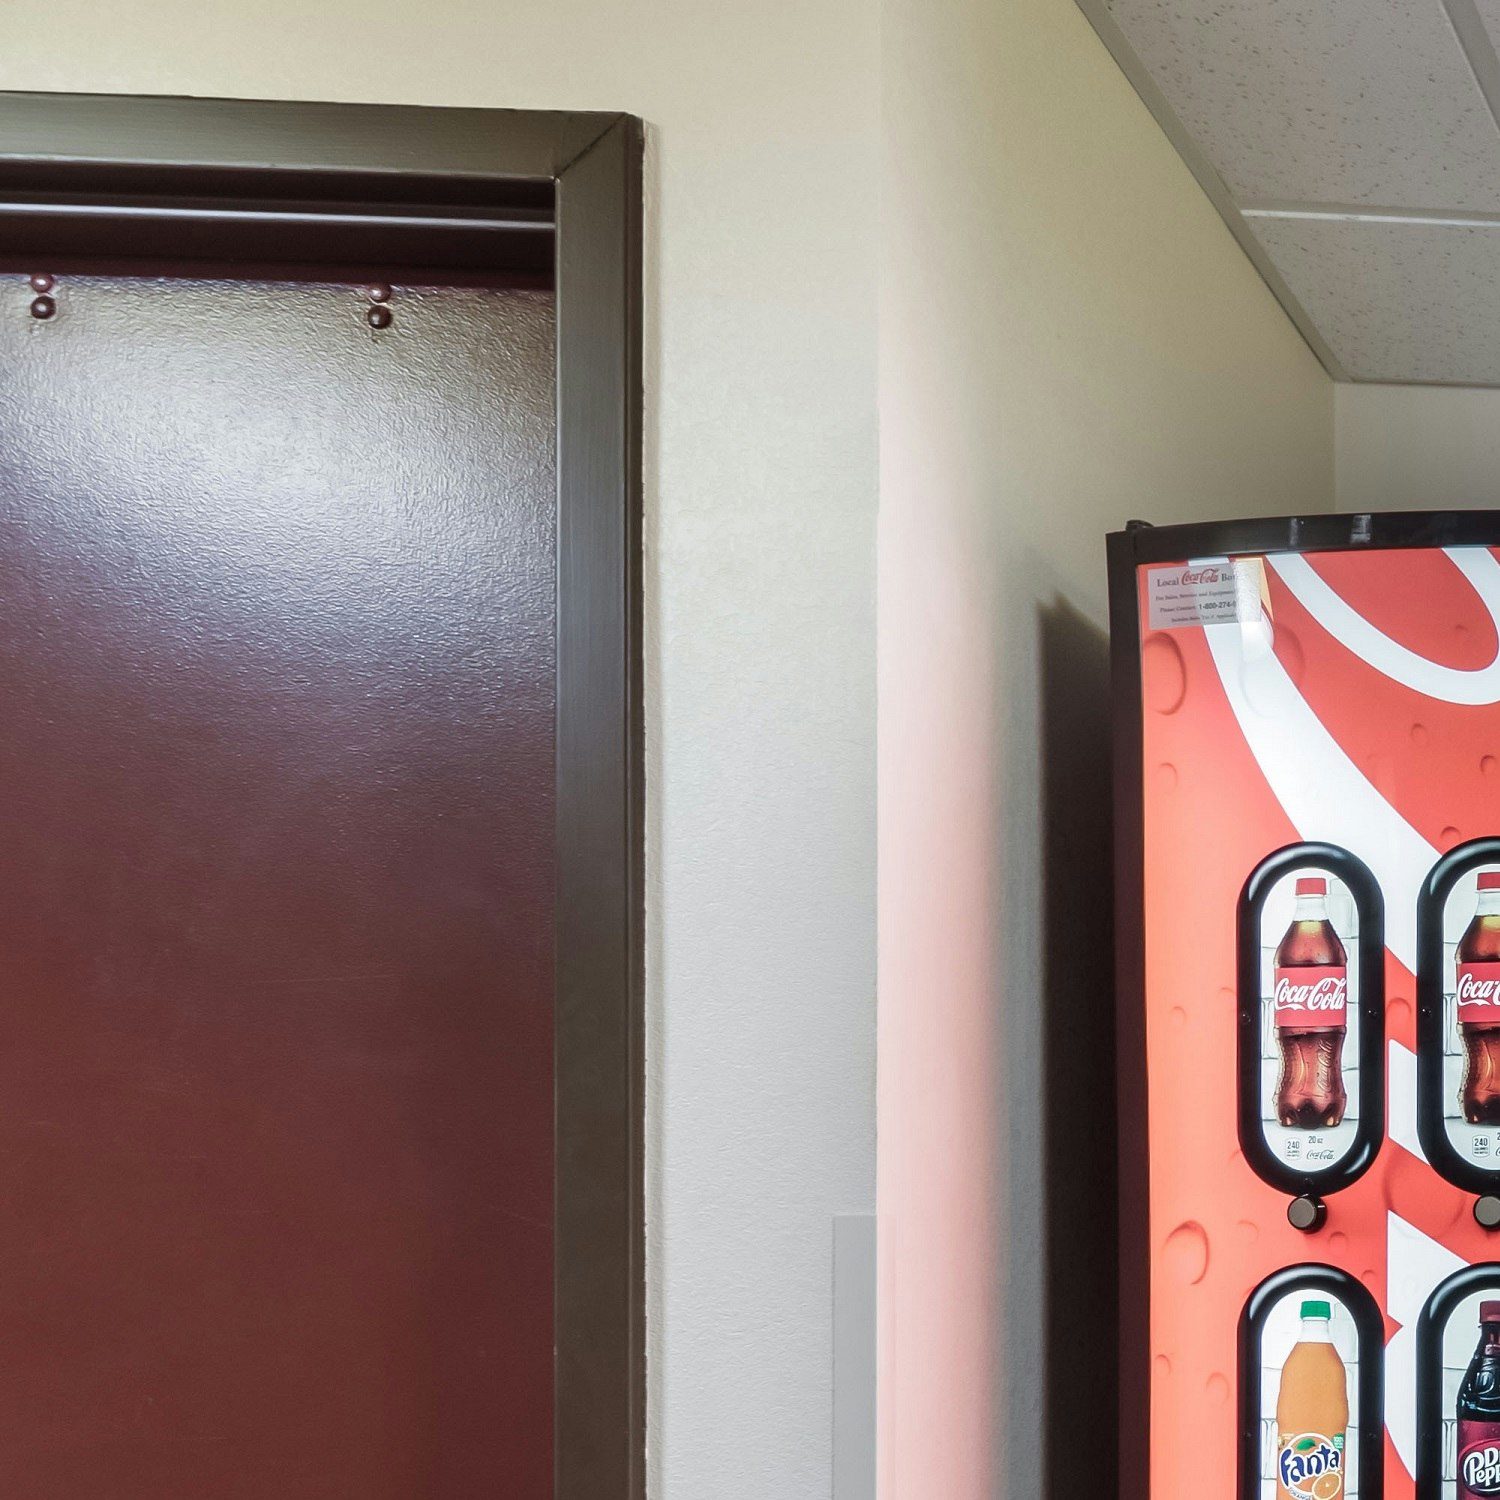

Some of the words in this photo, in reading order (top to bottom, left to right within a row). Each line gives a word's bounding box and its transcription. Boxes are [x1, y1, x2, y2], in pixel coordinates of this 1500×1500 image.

[1157, 577, 1179, 587] Local
[1274, 977, 1347, 1011] Coca-Cola
[1308, 1135, 1317, 1144] 20
[1474, 1137, 1488, 1147] 240
[1287, 1140, 1300, 1150] 240
[1280, 1444, 1340, 1488] Fanta
